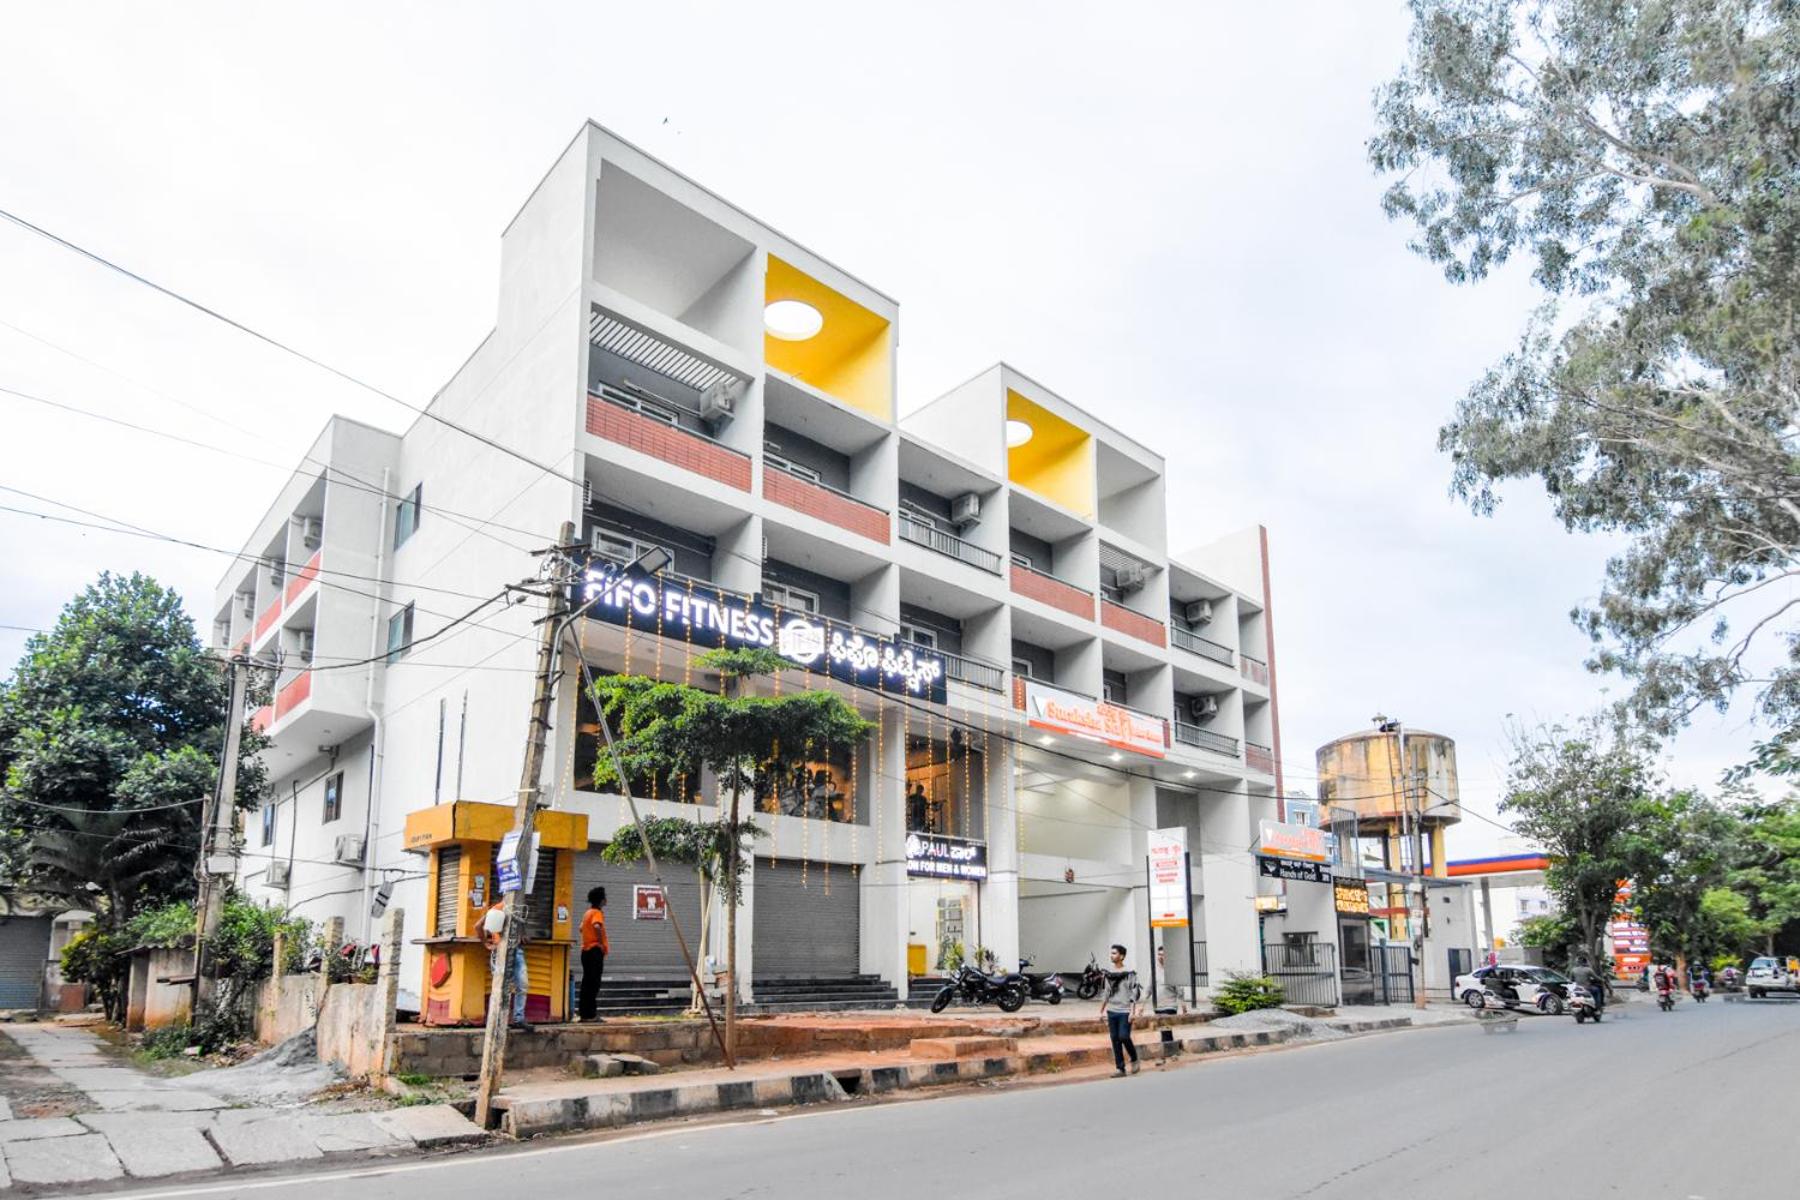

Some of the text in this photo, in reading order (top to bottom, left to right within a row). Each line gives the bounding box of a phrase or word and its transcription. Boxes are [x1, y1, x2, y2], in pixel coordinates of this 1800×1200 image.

[585, 570, 775, 647] FIFO FITNESS
[921, 841, 949, 858] PAUL
[920, 861, 935, 873] FOR
[936, 862, 953, 874] MEN
[953, 864, 960, 875] &
